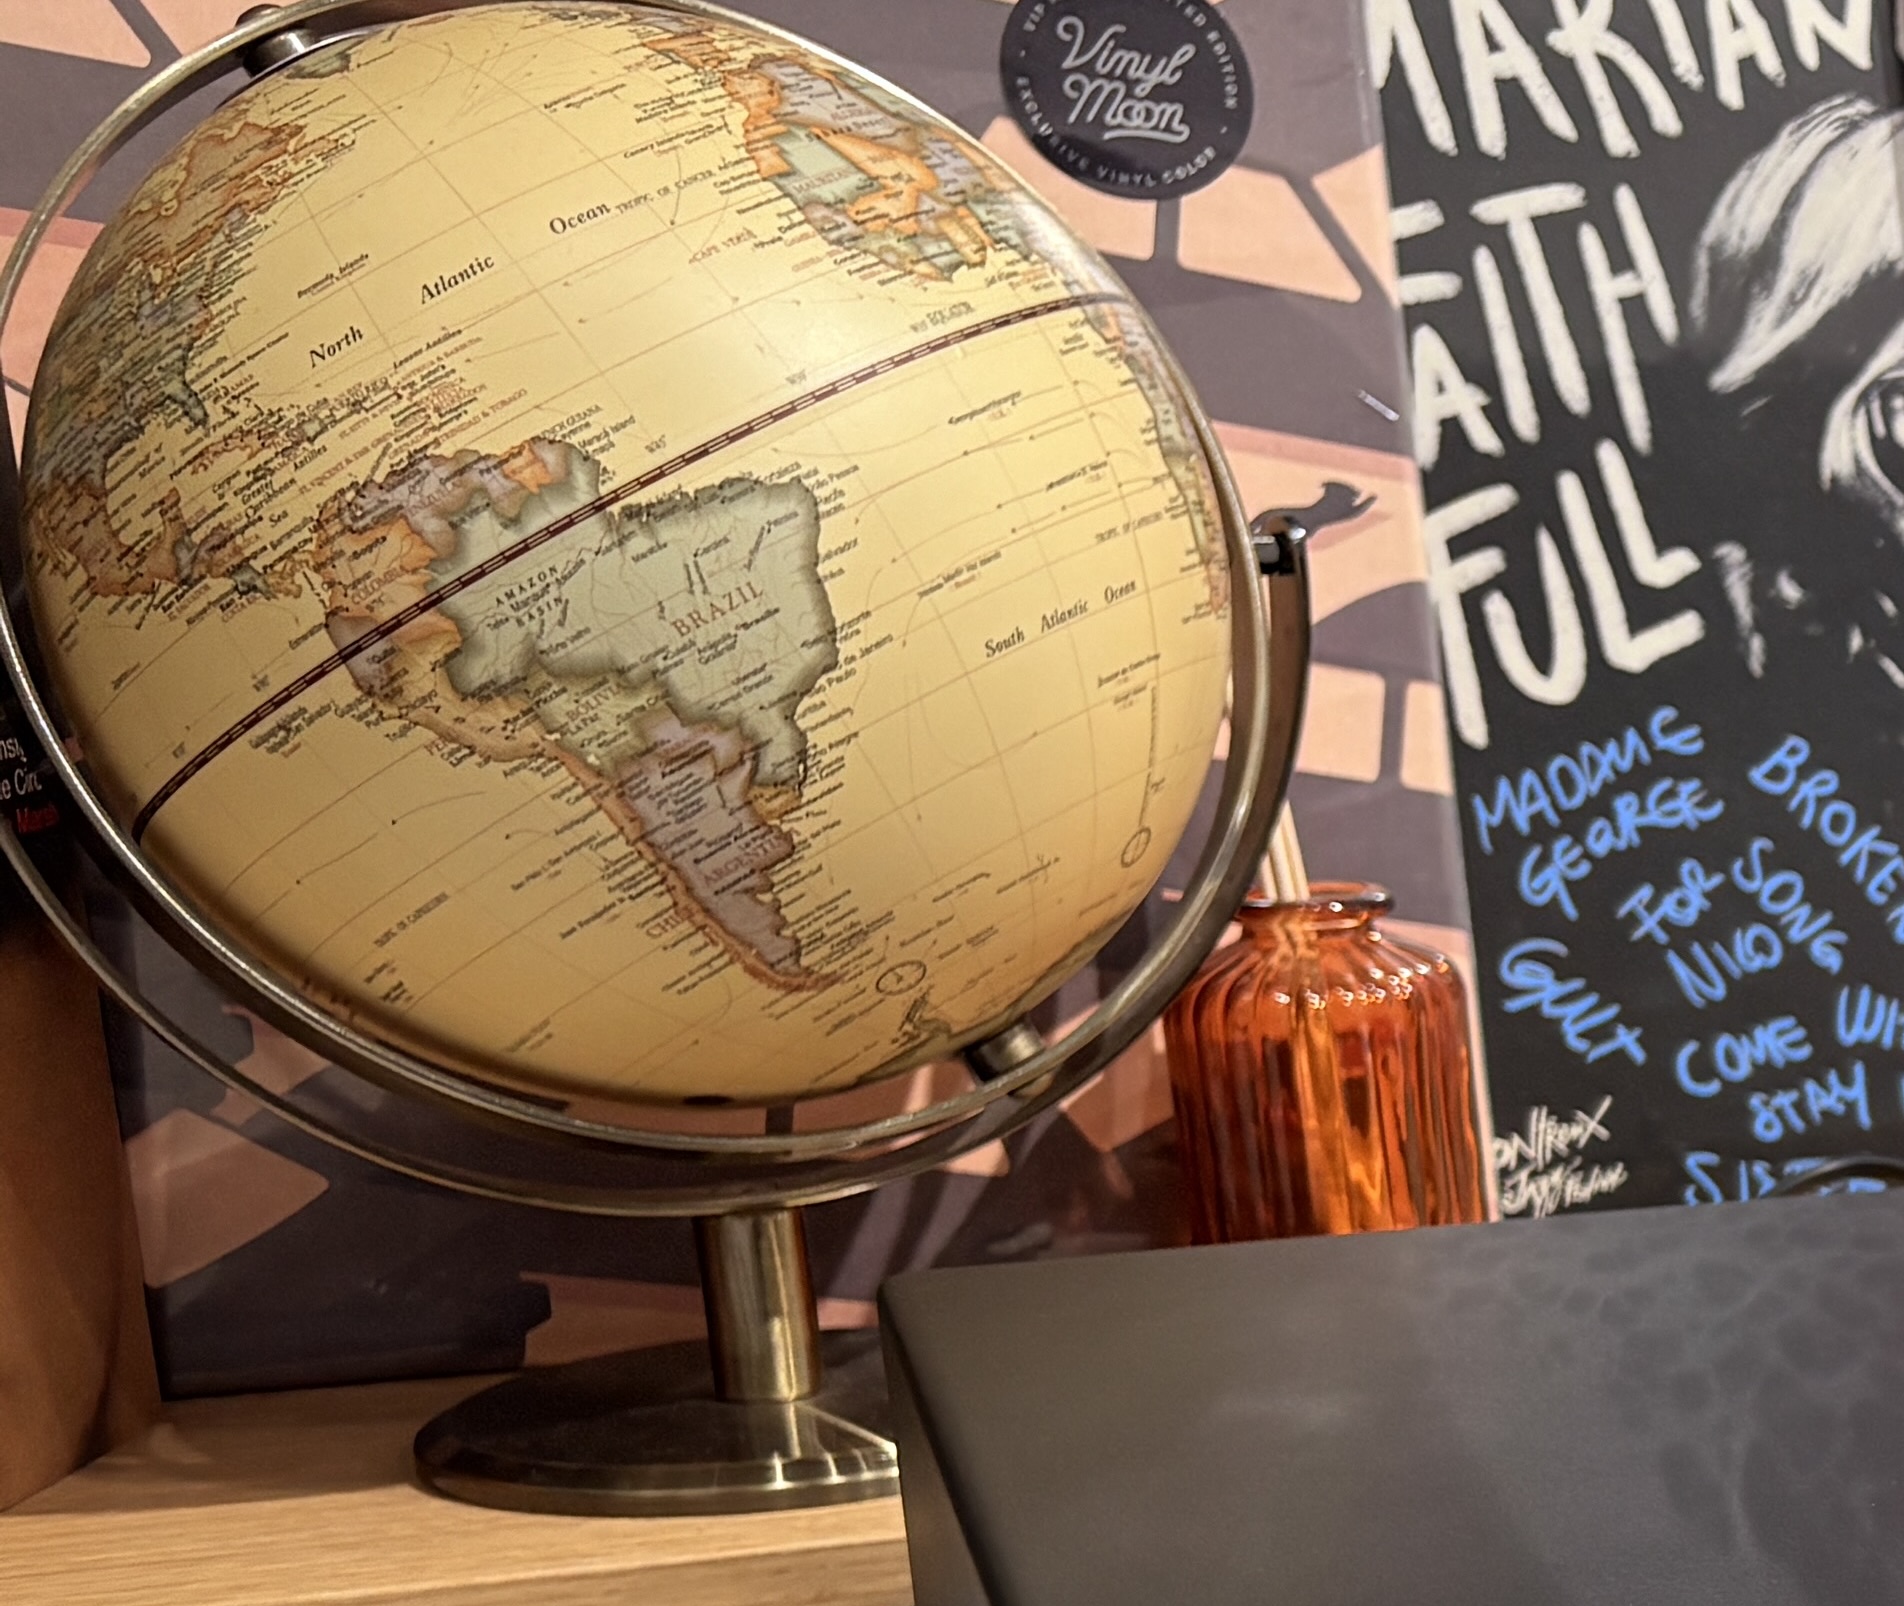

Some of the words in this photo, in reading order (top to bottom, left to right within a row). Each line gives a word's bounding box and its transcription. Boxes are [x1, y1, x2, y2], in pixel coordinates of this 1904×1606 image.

[1056, 16, 1197, 98] Vinyl
[1062, 73, 1191, 144] Moon
[308, 325, 365, 369] North
[420, 255, 496, 305] Atlantic
[548, 201, 611, 236] Ocean
[670, 580, 765, 639] BRAZIL
[982, 627, 1026, 660] South
[1039, 600, 1089, 633] Atlantic
[1103, 579, 1137, 605] Ocean
[1424, 438, 1705, 749] FULL
[1472, 705, 1705, 854] MADAME
[1519, 776, 1725, 921] GEORGE
[1616, 856, 1726, 945] FOR
[1731, 836, 1850, 976] SONG
[1674, 1015, 1813, 1099] COME
[1746, 1060, 1870, 1143] STAY
